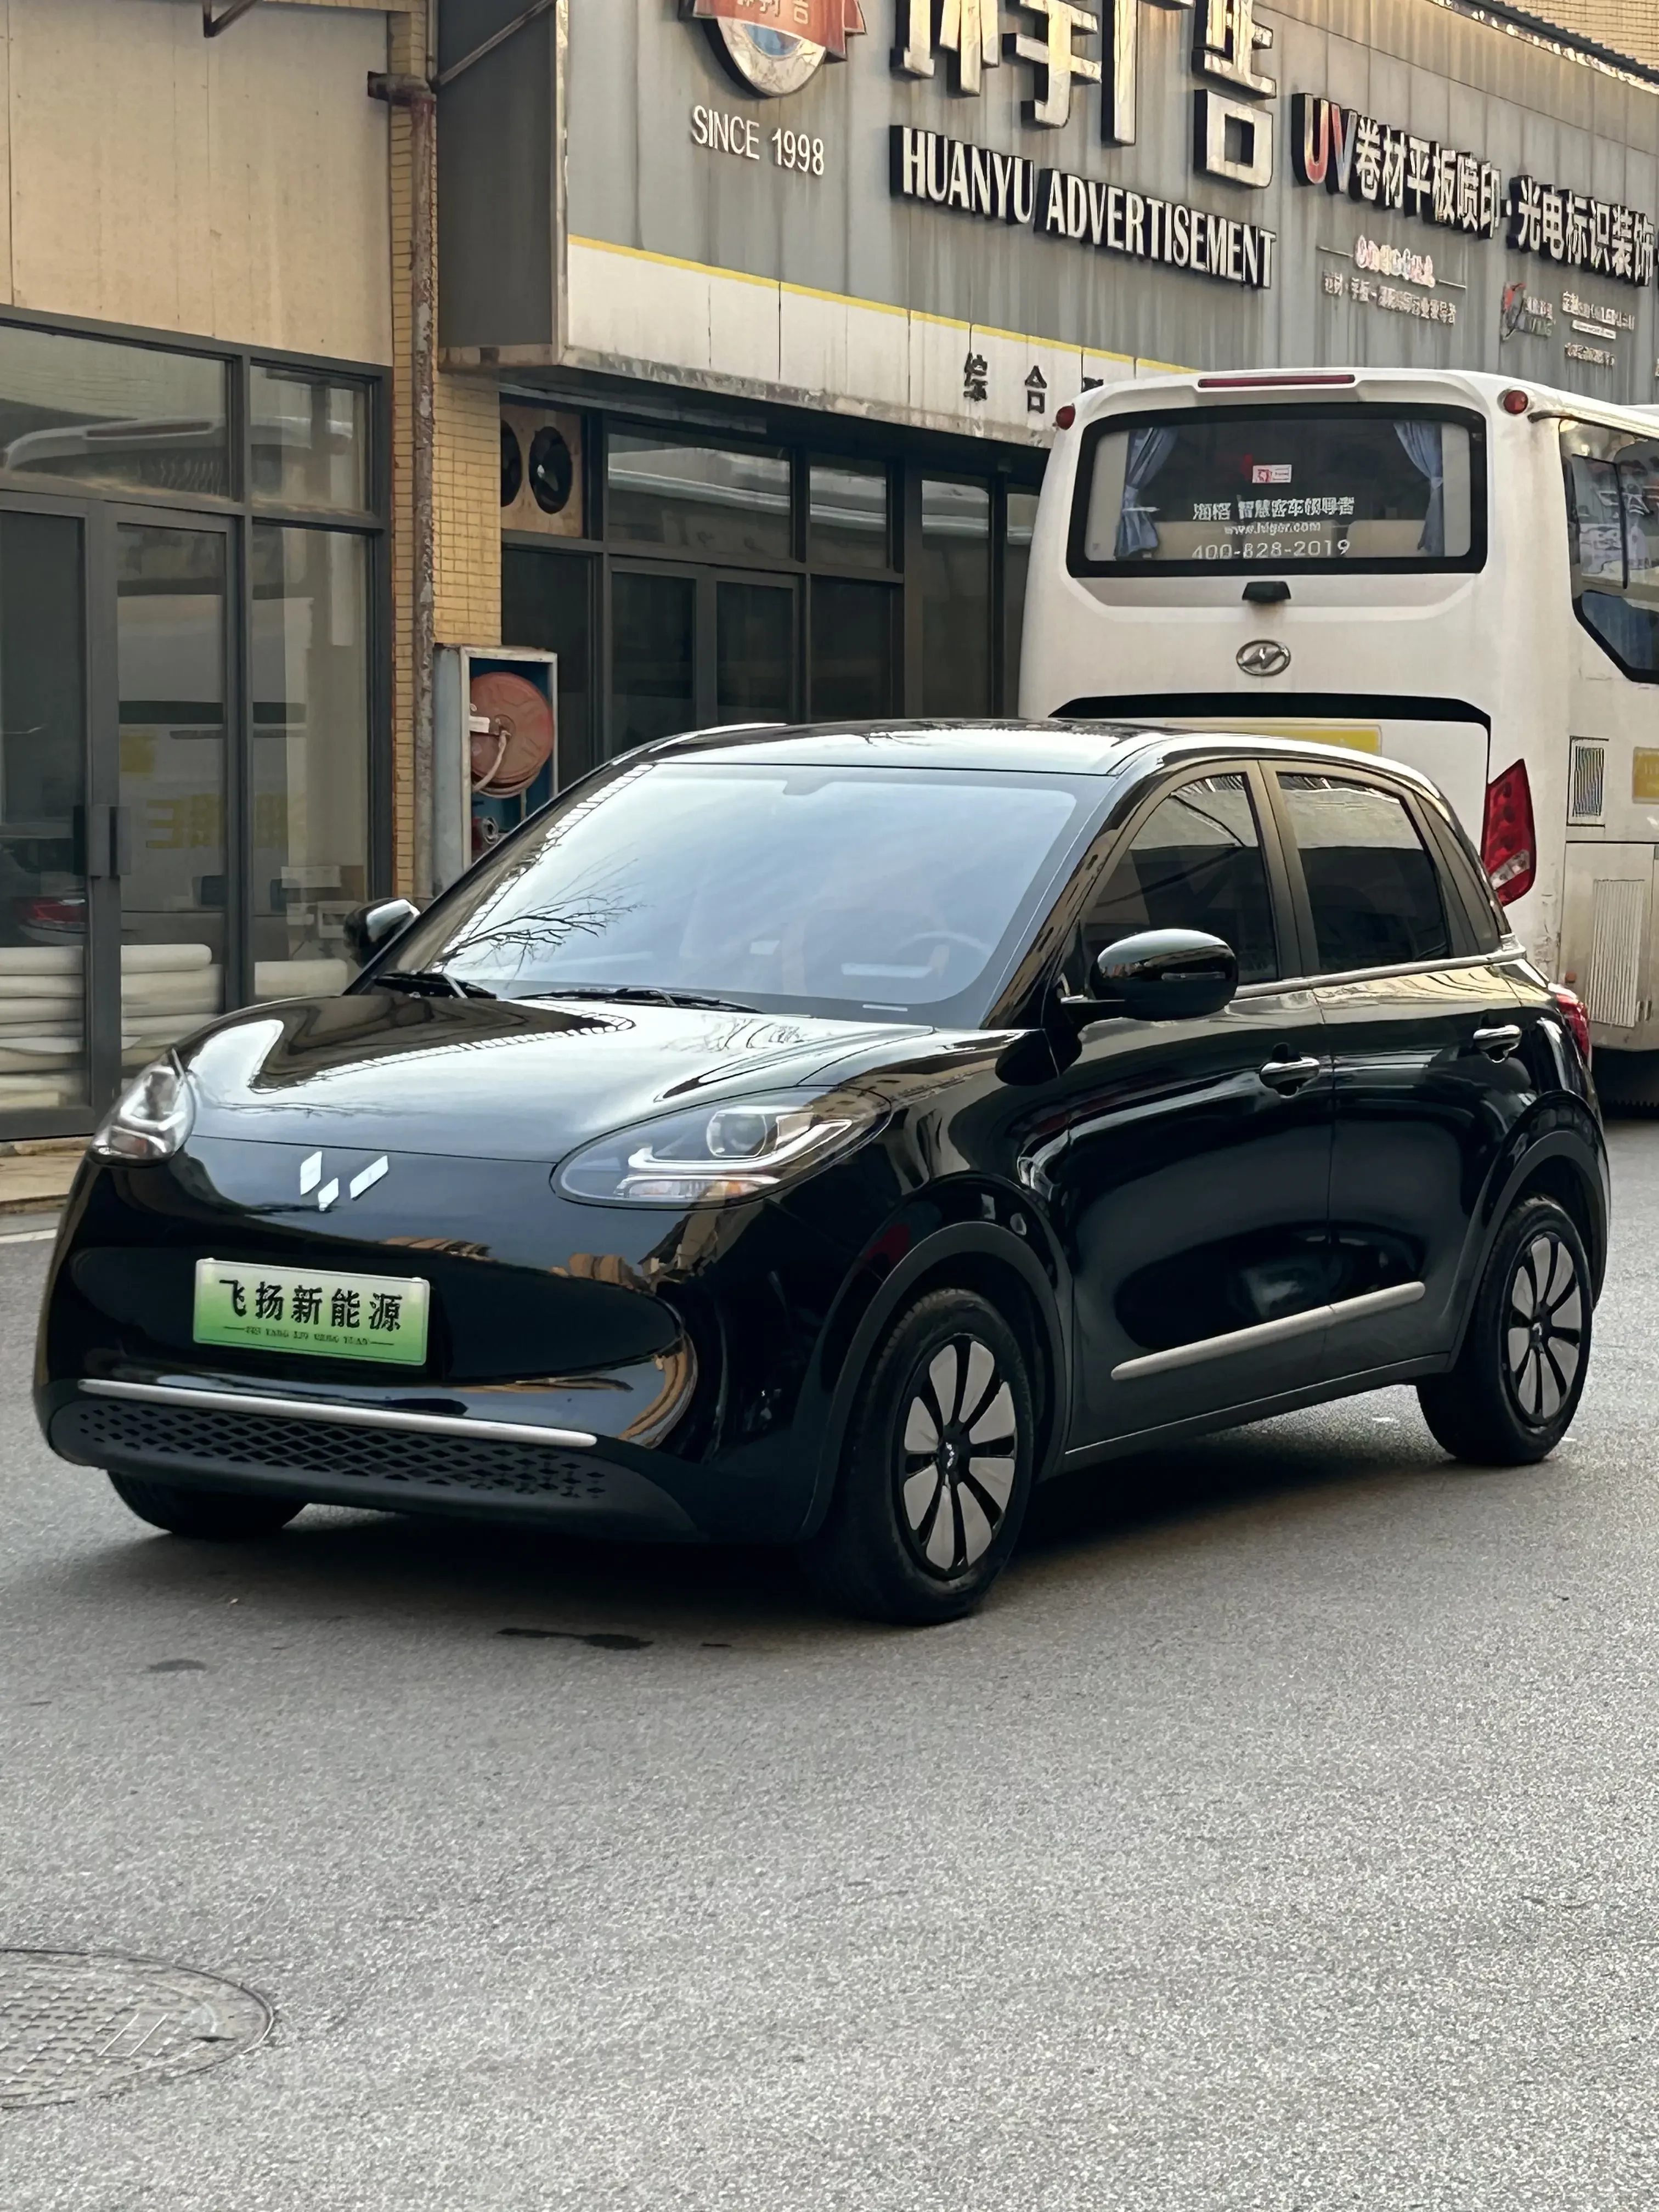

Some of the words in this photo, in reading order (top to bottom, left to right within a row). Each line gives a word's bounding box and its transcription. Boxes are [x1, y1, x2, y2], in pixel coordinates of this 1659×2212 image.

[692, 105, 760, 160] SINCE
[772, 128, 824, 176] 1998
[901, 127, 1034, 224] HUANYU
[1045, 169, 1277, 289] ADVERTISEMENT
[1192, 539, 1351, 560] 400-828-2019
[219, 1279, 403, 1332] 飞扬新能源
